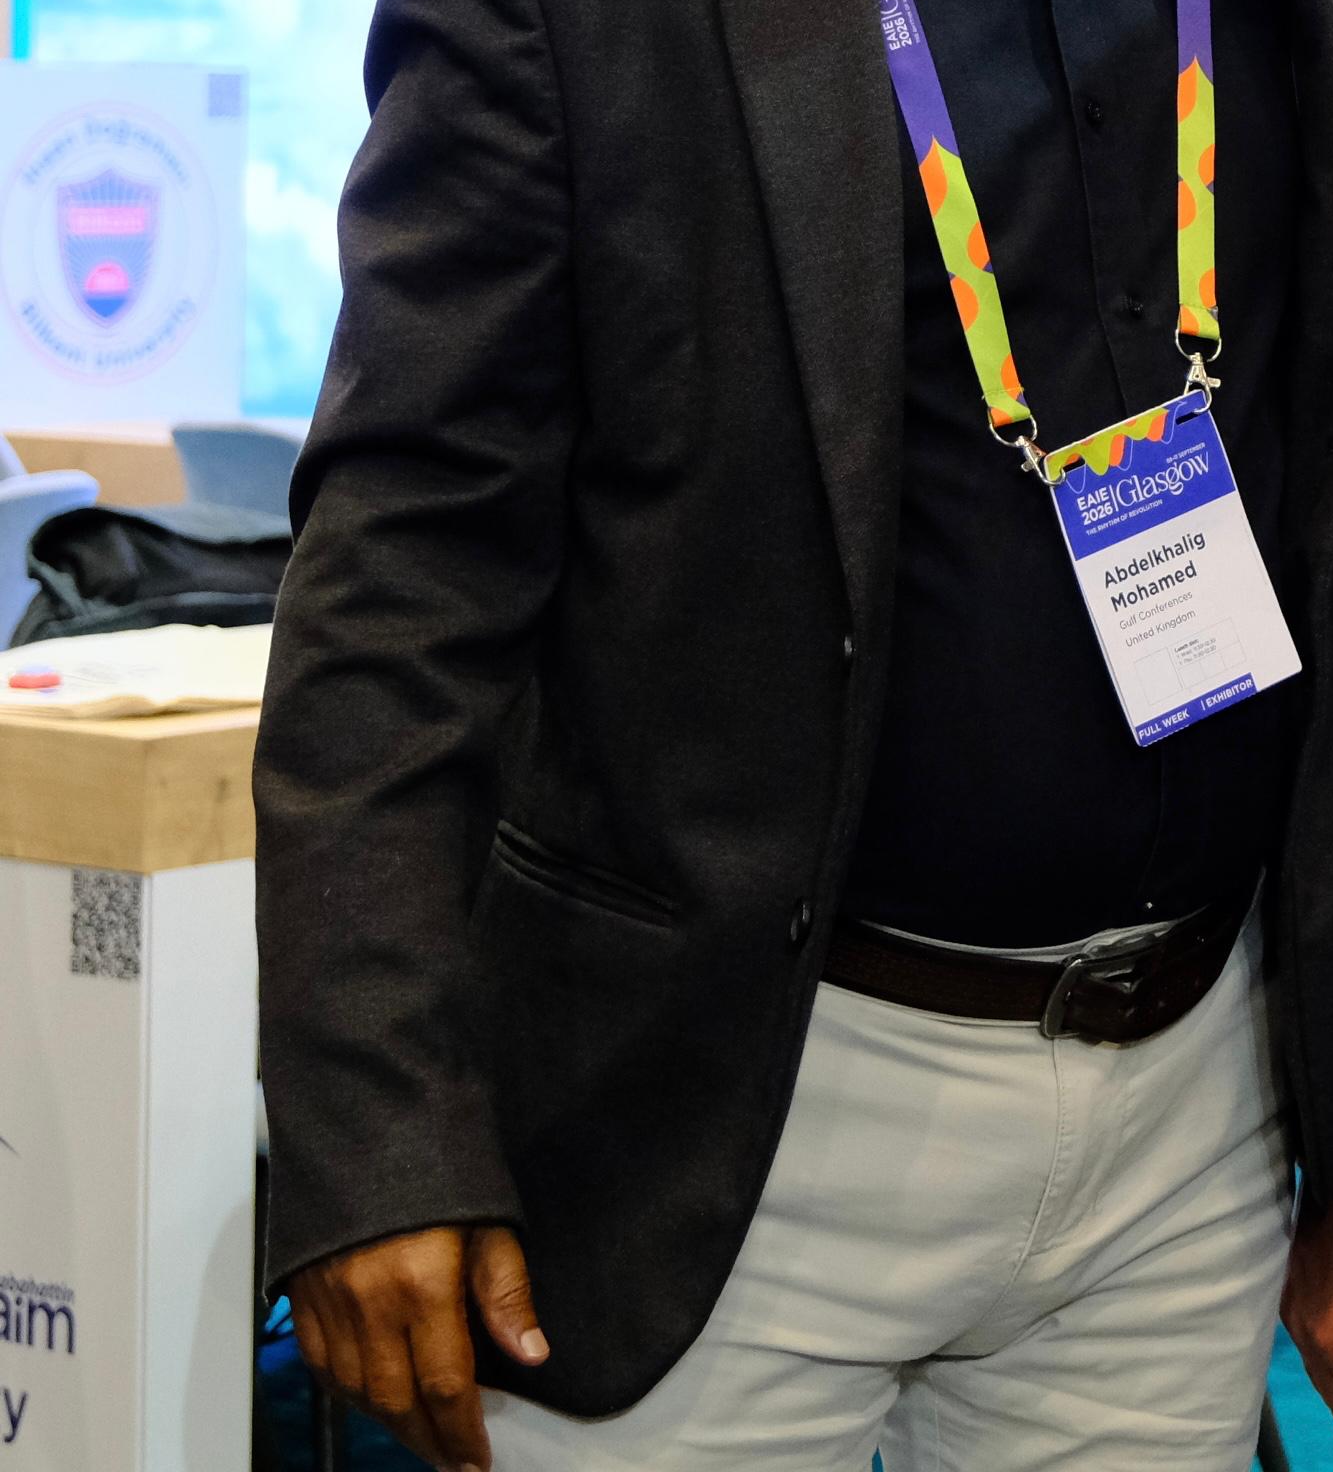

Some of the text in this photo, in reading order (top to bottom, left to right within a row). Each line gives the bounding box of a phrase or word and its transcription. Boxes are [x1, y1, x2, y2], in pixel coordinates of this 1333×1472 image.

[882, 20, 901, 51] EAIE
[894, 17, 913, 47] 2026
[1116, 451, 1209, 507] Glasgow
[1077, 487, 1109, 512] EAIE
[1081, 502, 1114, 526] 2026
[1120, 511, 1129, 522] OF
[1128, 499, 1163, 518] REVOLUTION
[1103, 530, 1208, 589] Abdelkhalig
[1110, 560, 1198, 612] Mohamed
[1119, 590, 1194, 631] Gulf Conferences
[1125, 608, 1197, 648] United Kingdom
[1138, 678, 1255, 741] FULL WEEK EXHIBITOR
